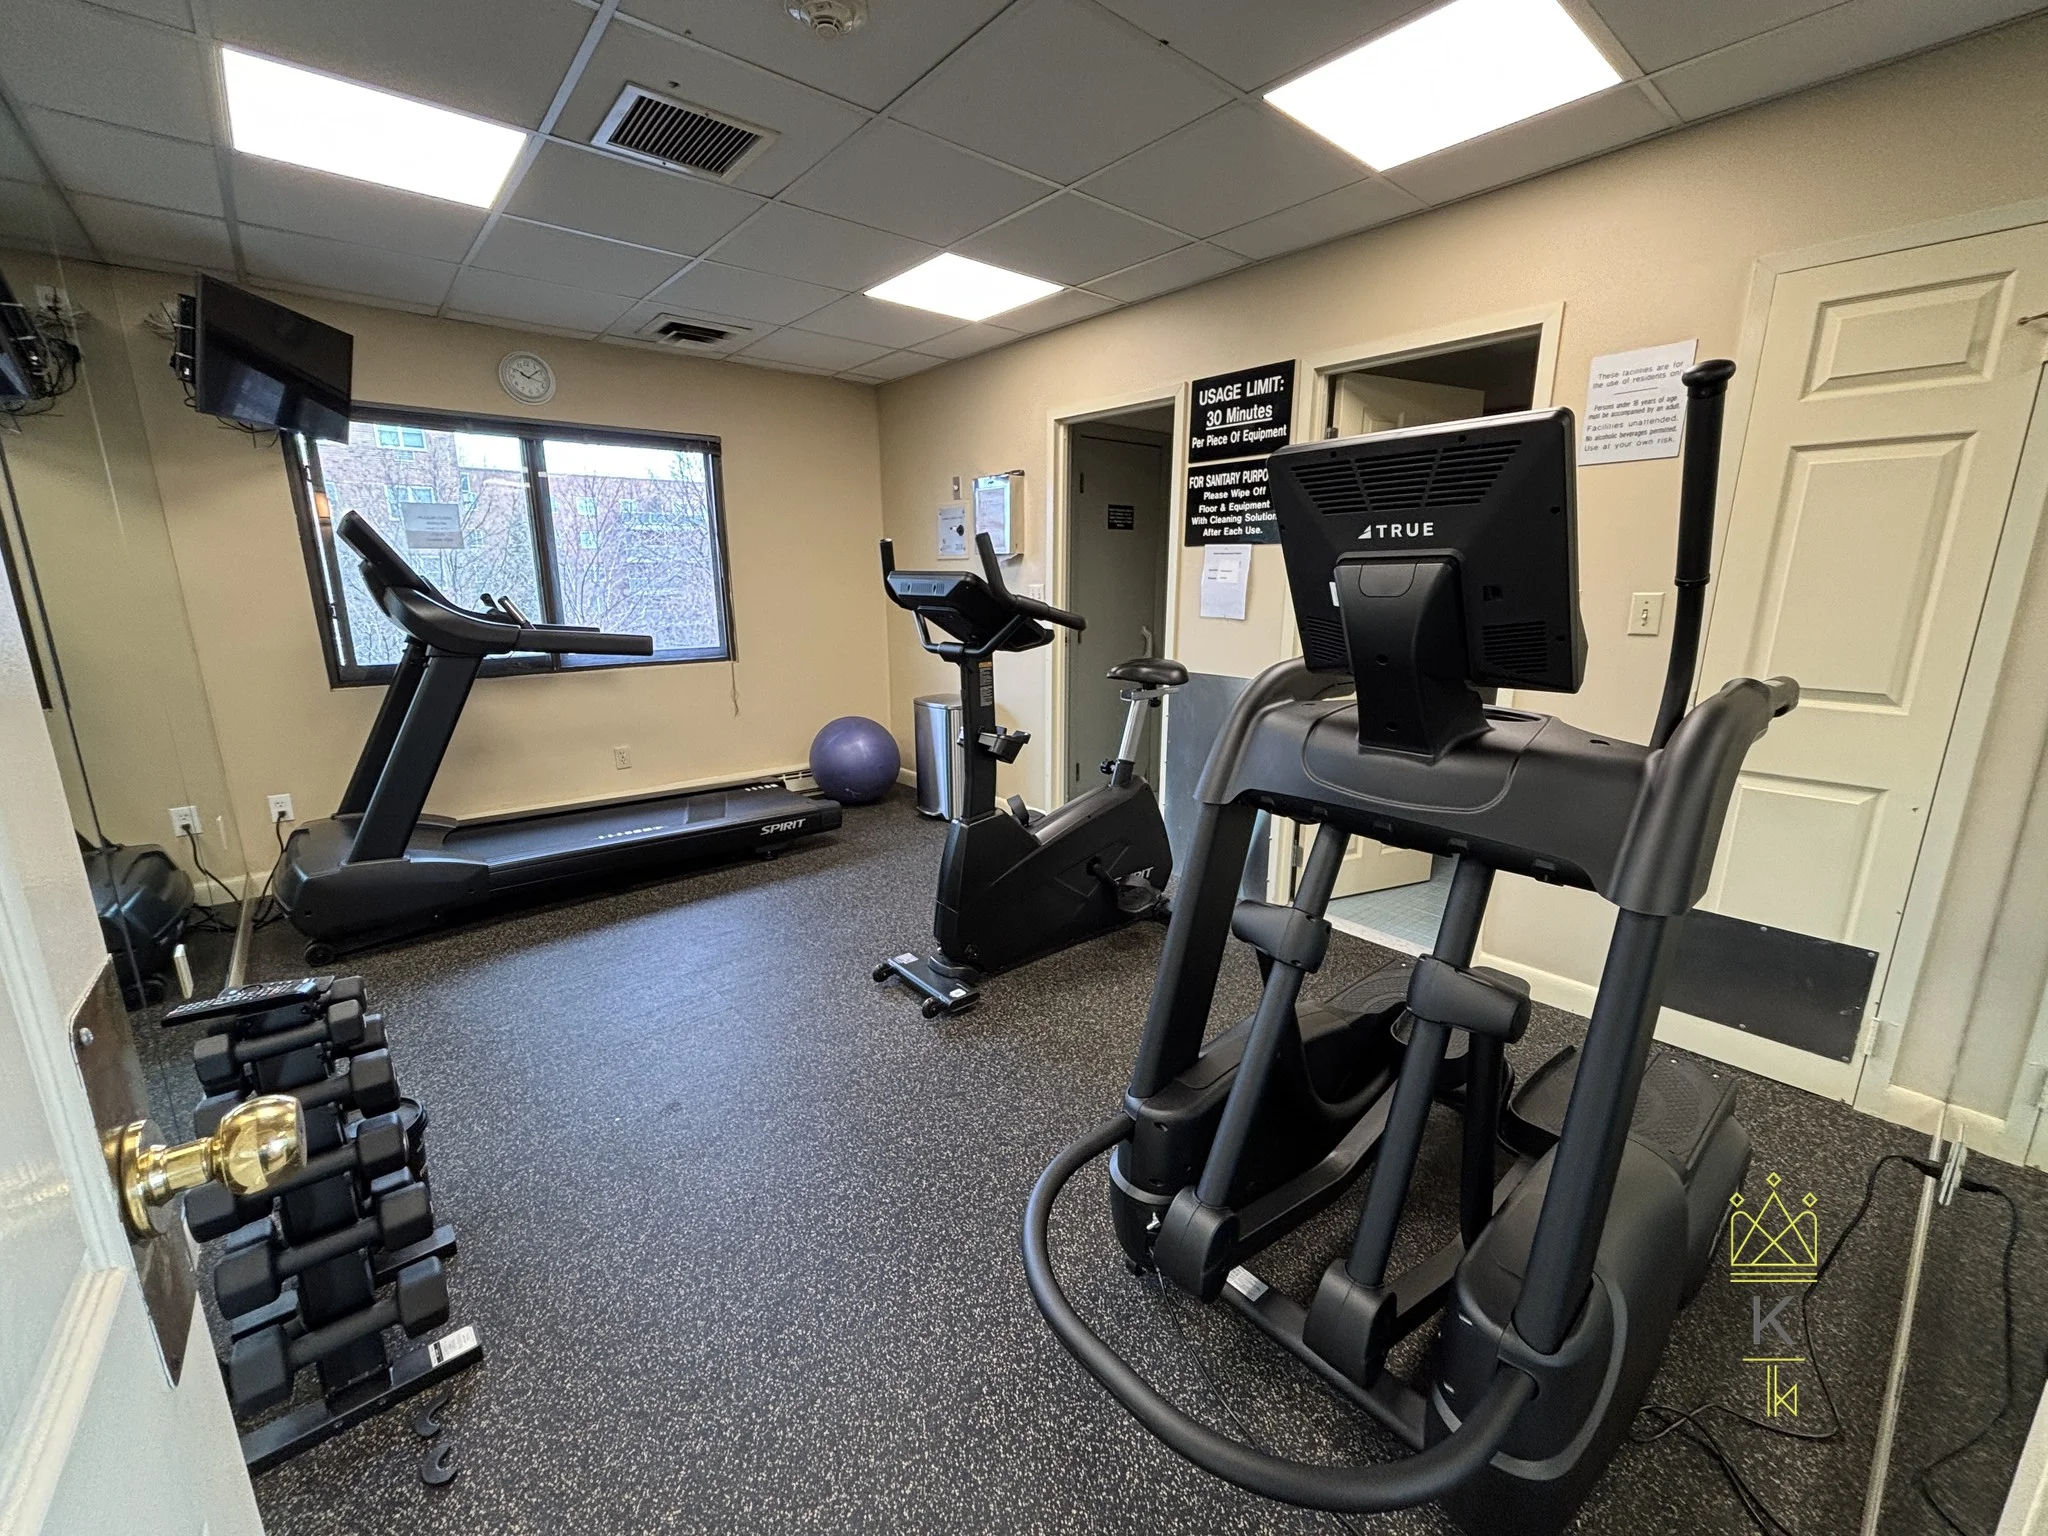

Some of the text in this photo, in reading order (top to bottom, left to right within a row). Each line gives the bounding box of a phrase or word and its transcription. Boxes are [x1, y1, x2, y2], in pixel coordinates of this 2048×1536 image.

[1599, 372, 1619, 380] These
[1622, 367, 1652, 376] facilities
[1632, 372, 1666, 383] residents
[1199, 375, 1284, 405] USAGE LIMIT:
[1641, 398, 1656, 406] years
[1206, 404, 1272, 426] 30 Minutes
[1611, 407, 1645, 417] accompanied
[1587, 422, 1624, 432] Facilities
[1192, 424, 1287, 448] Per Piece Of Equipment
[1595, 433, 1618, 441] alcoholic
[1619, 430, 1647, 438] beverages
[1615, 441, 1633, 450] your
[1189, 468, 1269, 489] FOR SANITARY PURPO
[1203, 486, 1266, 500] Please Wipe Off
[1199, 500, 1270, 513] Floor & Equipment
[1191, 516, 1208, 525] With
[1210, 515, 1242, 524] Cleaning
[1202, 526, 1263, 536] After Each Use.
[1376, 522, 1434, 538] TRUE
[760, 818, 806, 836] SPIRIT
